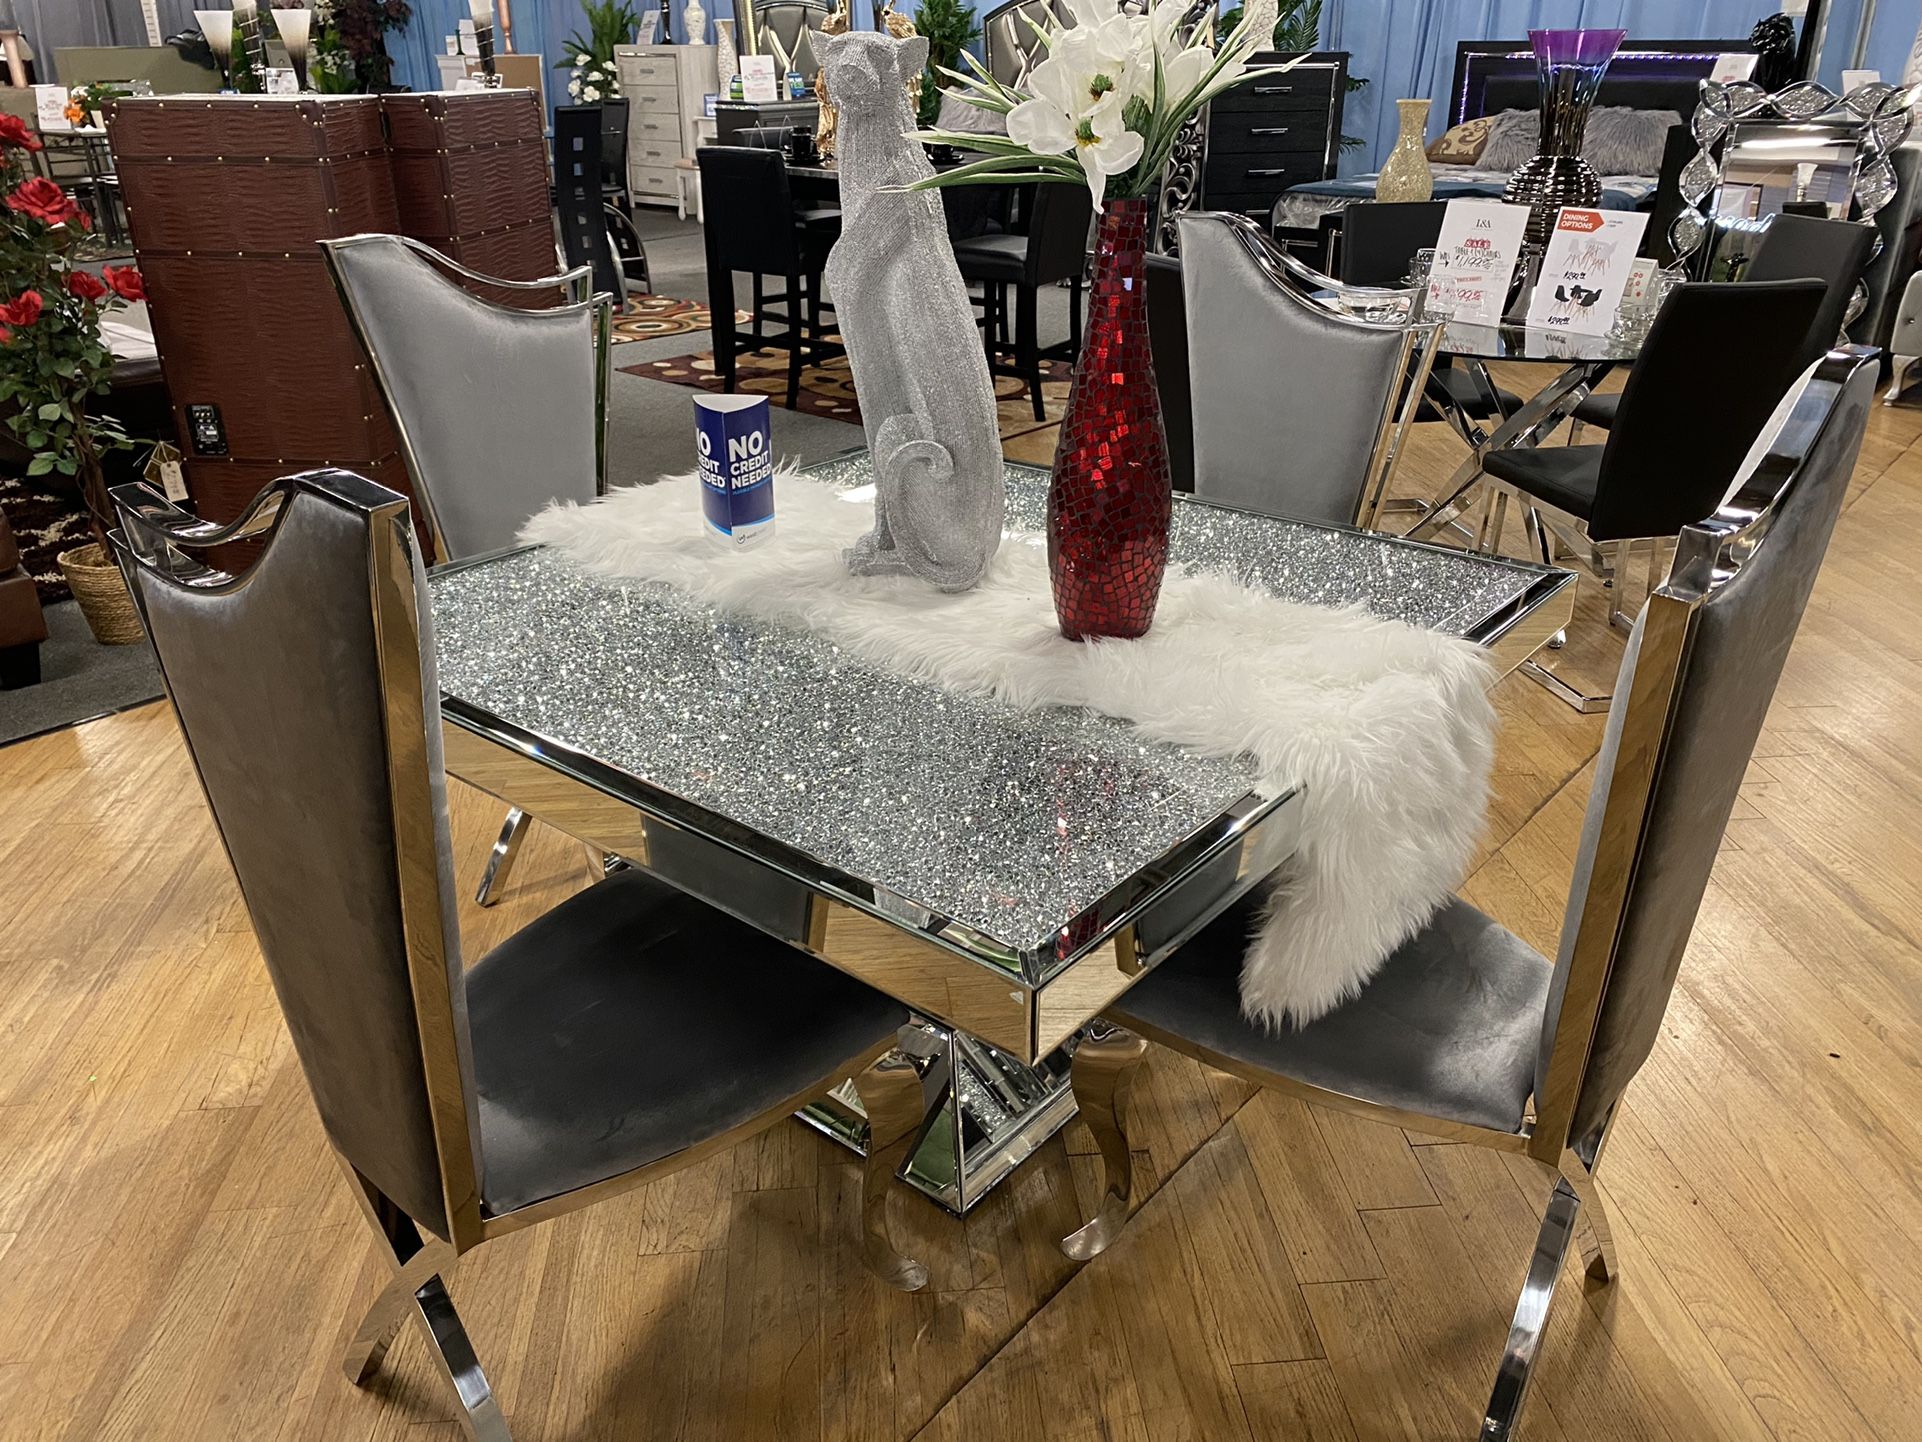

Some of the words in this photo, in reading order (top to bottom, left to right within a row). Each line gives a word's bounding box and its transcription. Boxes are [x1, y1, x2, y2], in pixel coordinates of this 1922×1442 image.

[1561, 220, 1593, 229] OPTIONS
[1563, 213, 1590, 221] DINING
[1465, 240, 1490, 249] SALE
[728, 430, 763, 463] NO
[698, 452, 720, 473] EDIT
[730, 450, 769, 476] CREDIT
[731, 463, 771, 490] NEEDED
